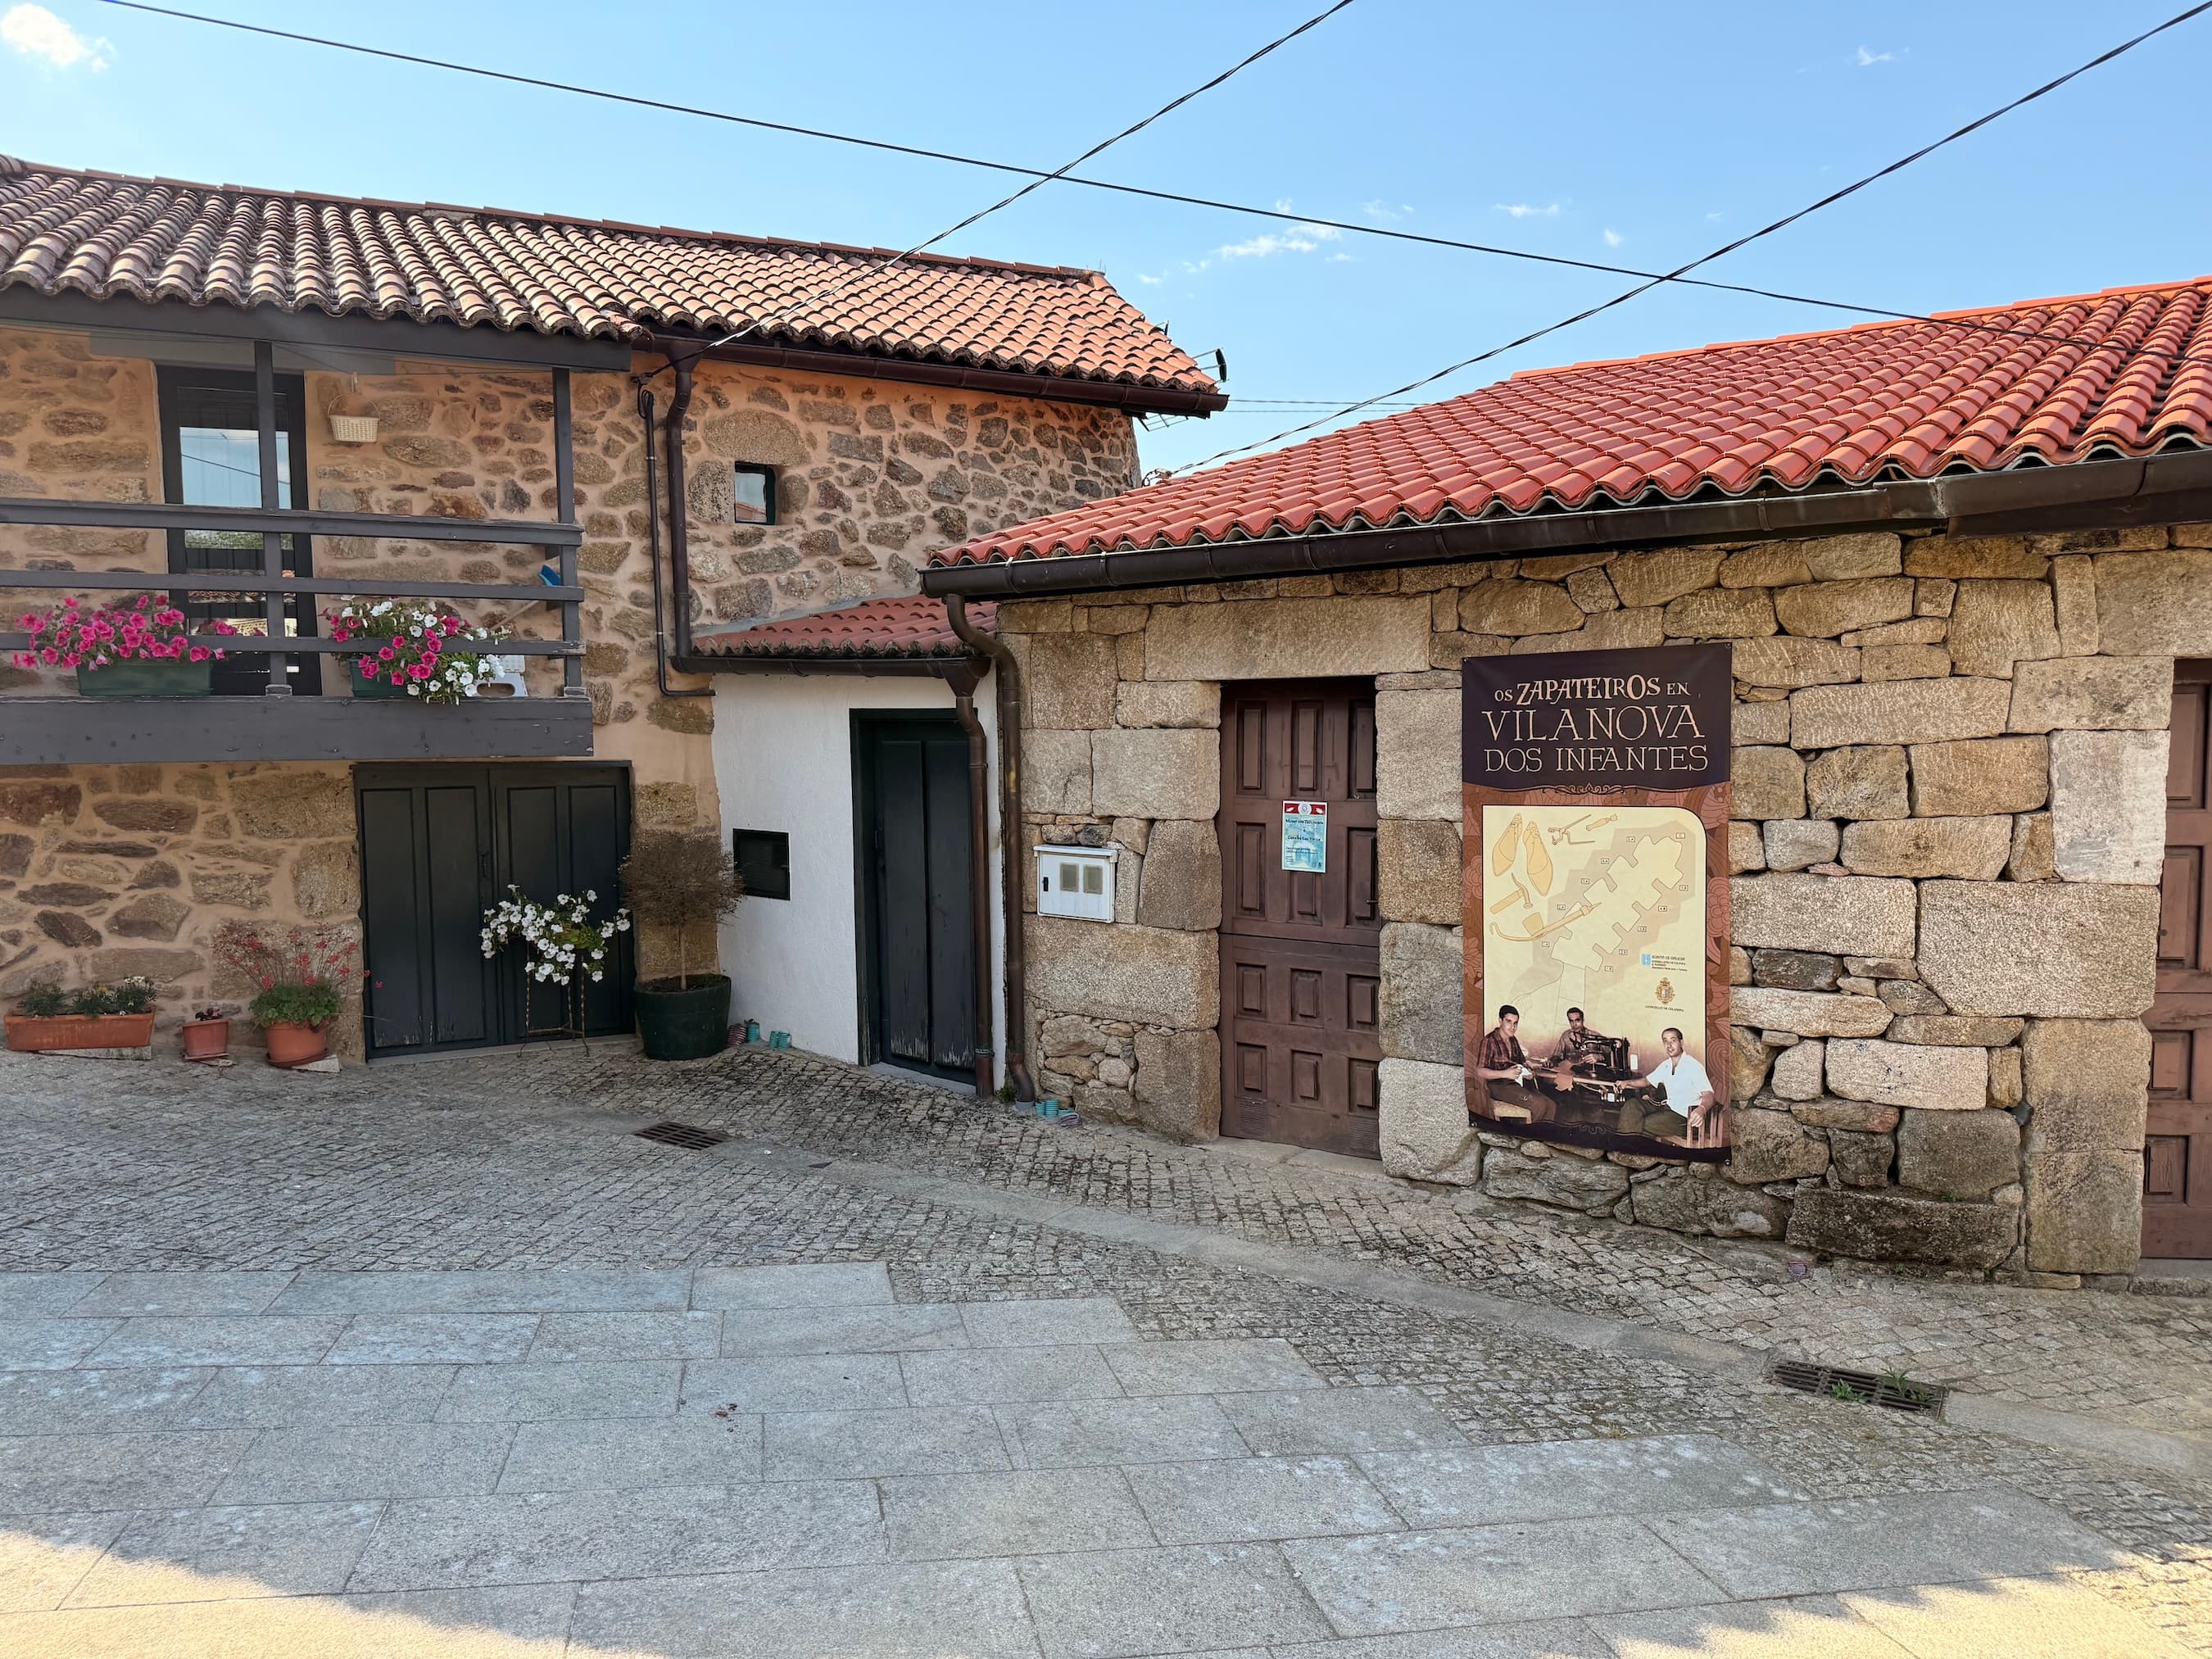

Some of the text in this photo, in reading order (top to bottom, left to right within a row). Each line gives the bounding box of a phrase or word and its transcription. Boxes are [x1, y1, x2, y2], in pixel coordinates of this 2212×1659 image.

[1494, 674, 1691, 705] OS ZAPATEIROS EN
[1481, 705, 1705, 741] VILANOVA
[1484, 745, 1709, 773] DOS INFANTES
